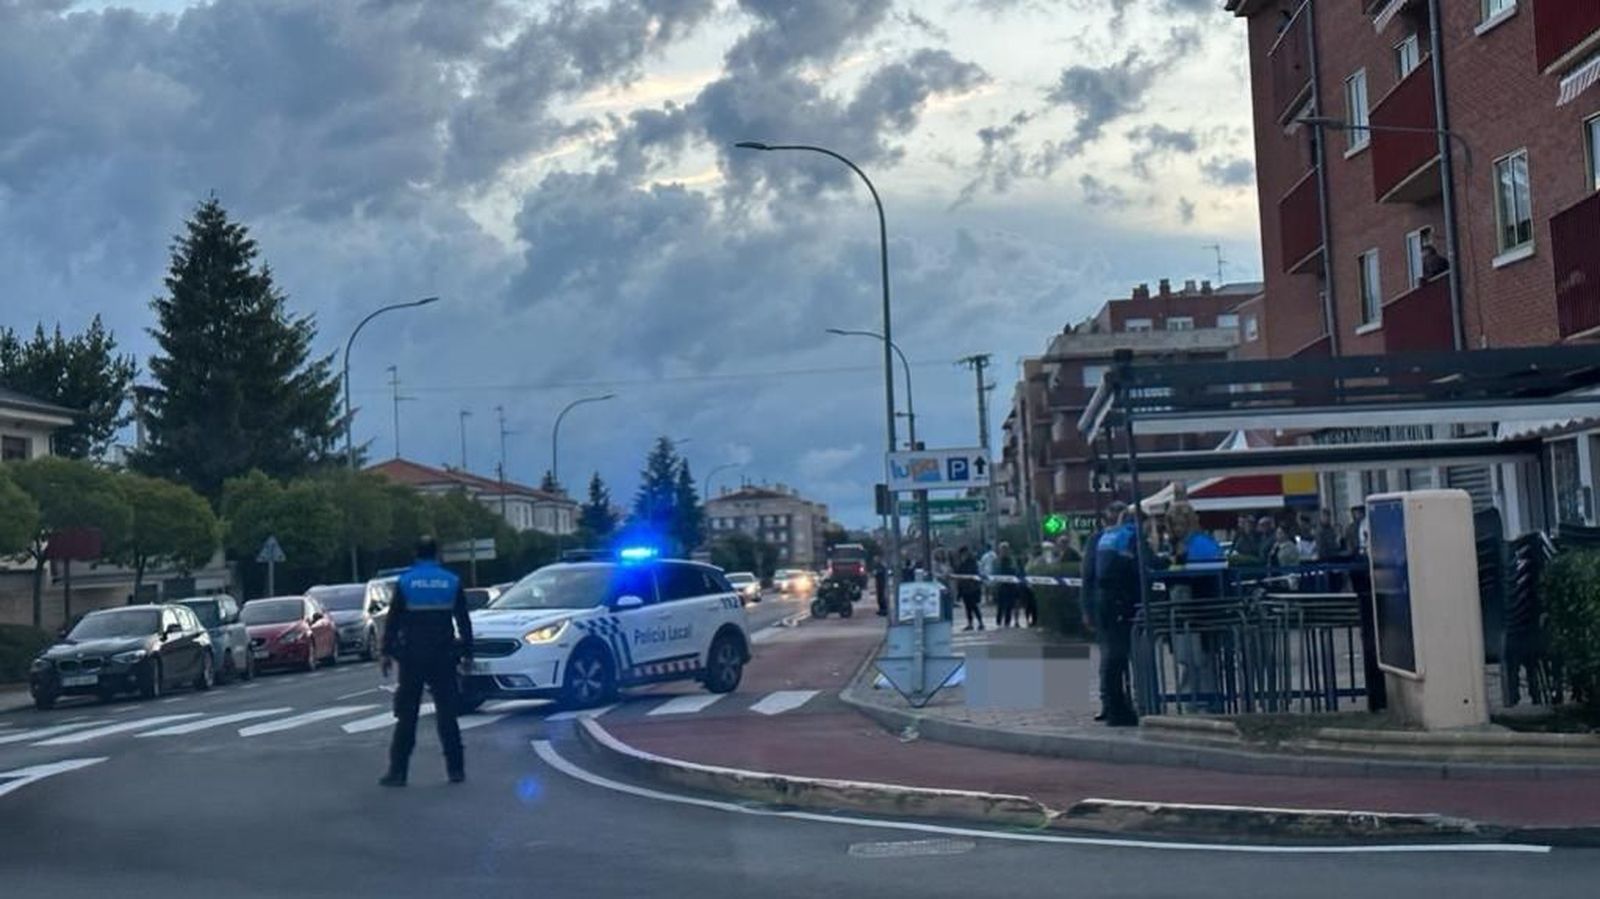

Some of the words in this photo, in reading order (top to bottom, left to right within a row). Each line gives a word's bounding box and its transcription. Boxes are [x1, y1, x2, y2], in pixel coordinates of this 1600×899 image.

[951, 460, 967, 478] P
[720, 596, 739, 609] 112
[668, 623, 692, 641] Local
